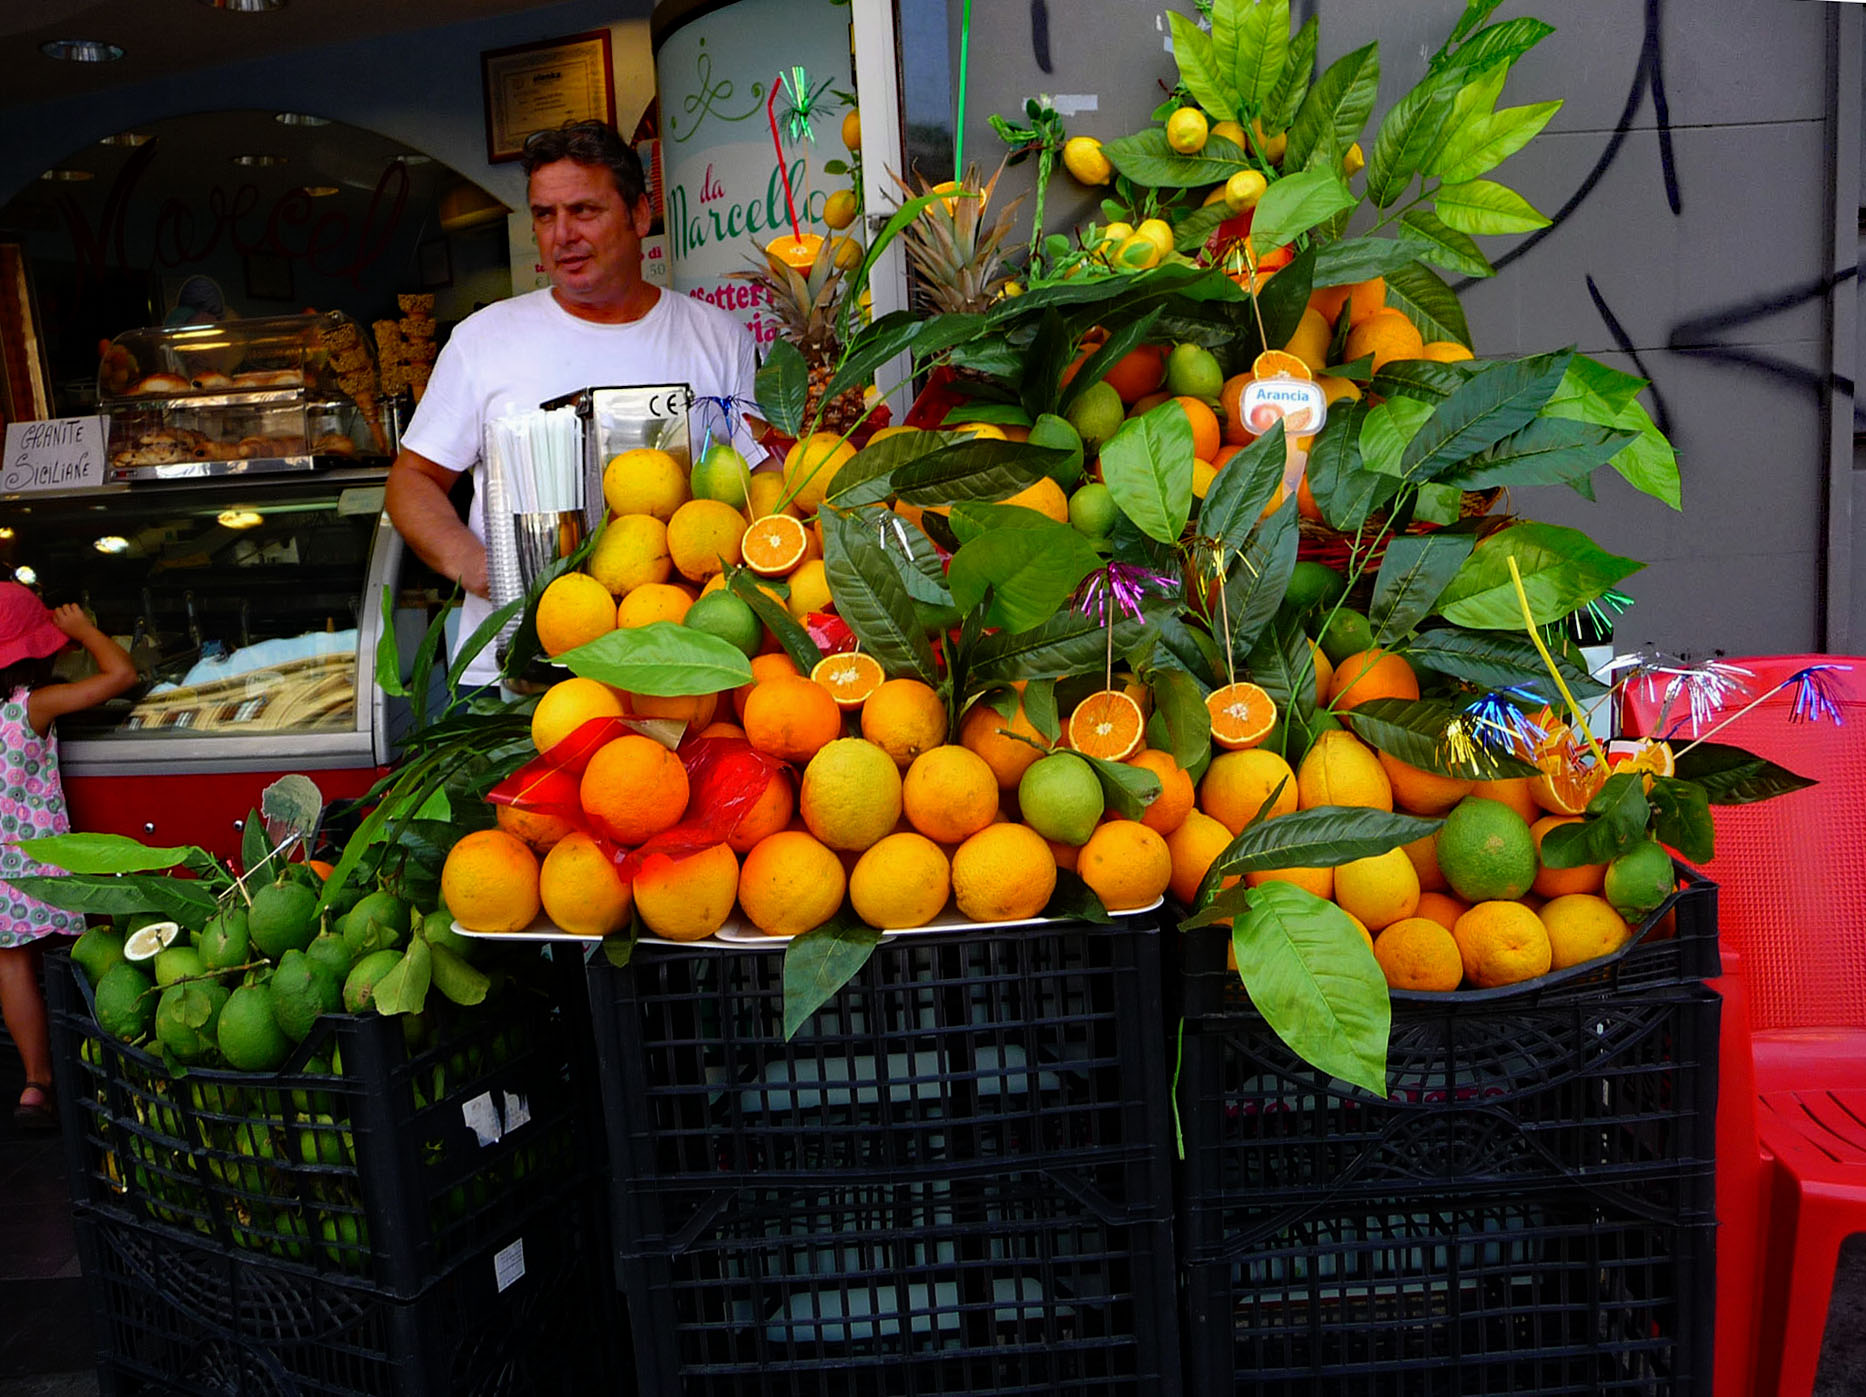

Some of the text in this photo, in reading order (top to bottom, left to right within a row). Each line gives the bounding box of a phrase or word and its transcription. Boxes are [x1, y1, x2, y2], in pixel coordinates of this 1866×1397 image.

[700, 163, 726, 204] da
[667, 159, 828, 261] Marcello
[650, 394, 678, 417] CE
[1256, 388, 1309, 402] Arancia
[21, 421, 84, 449] GRANITE
